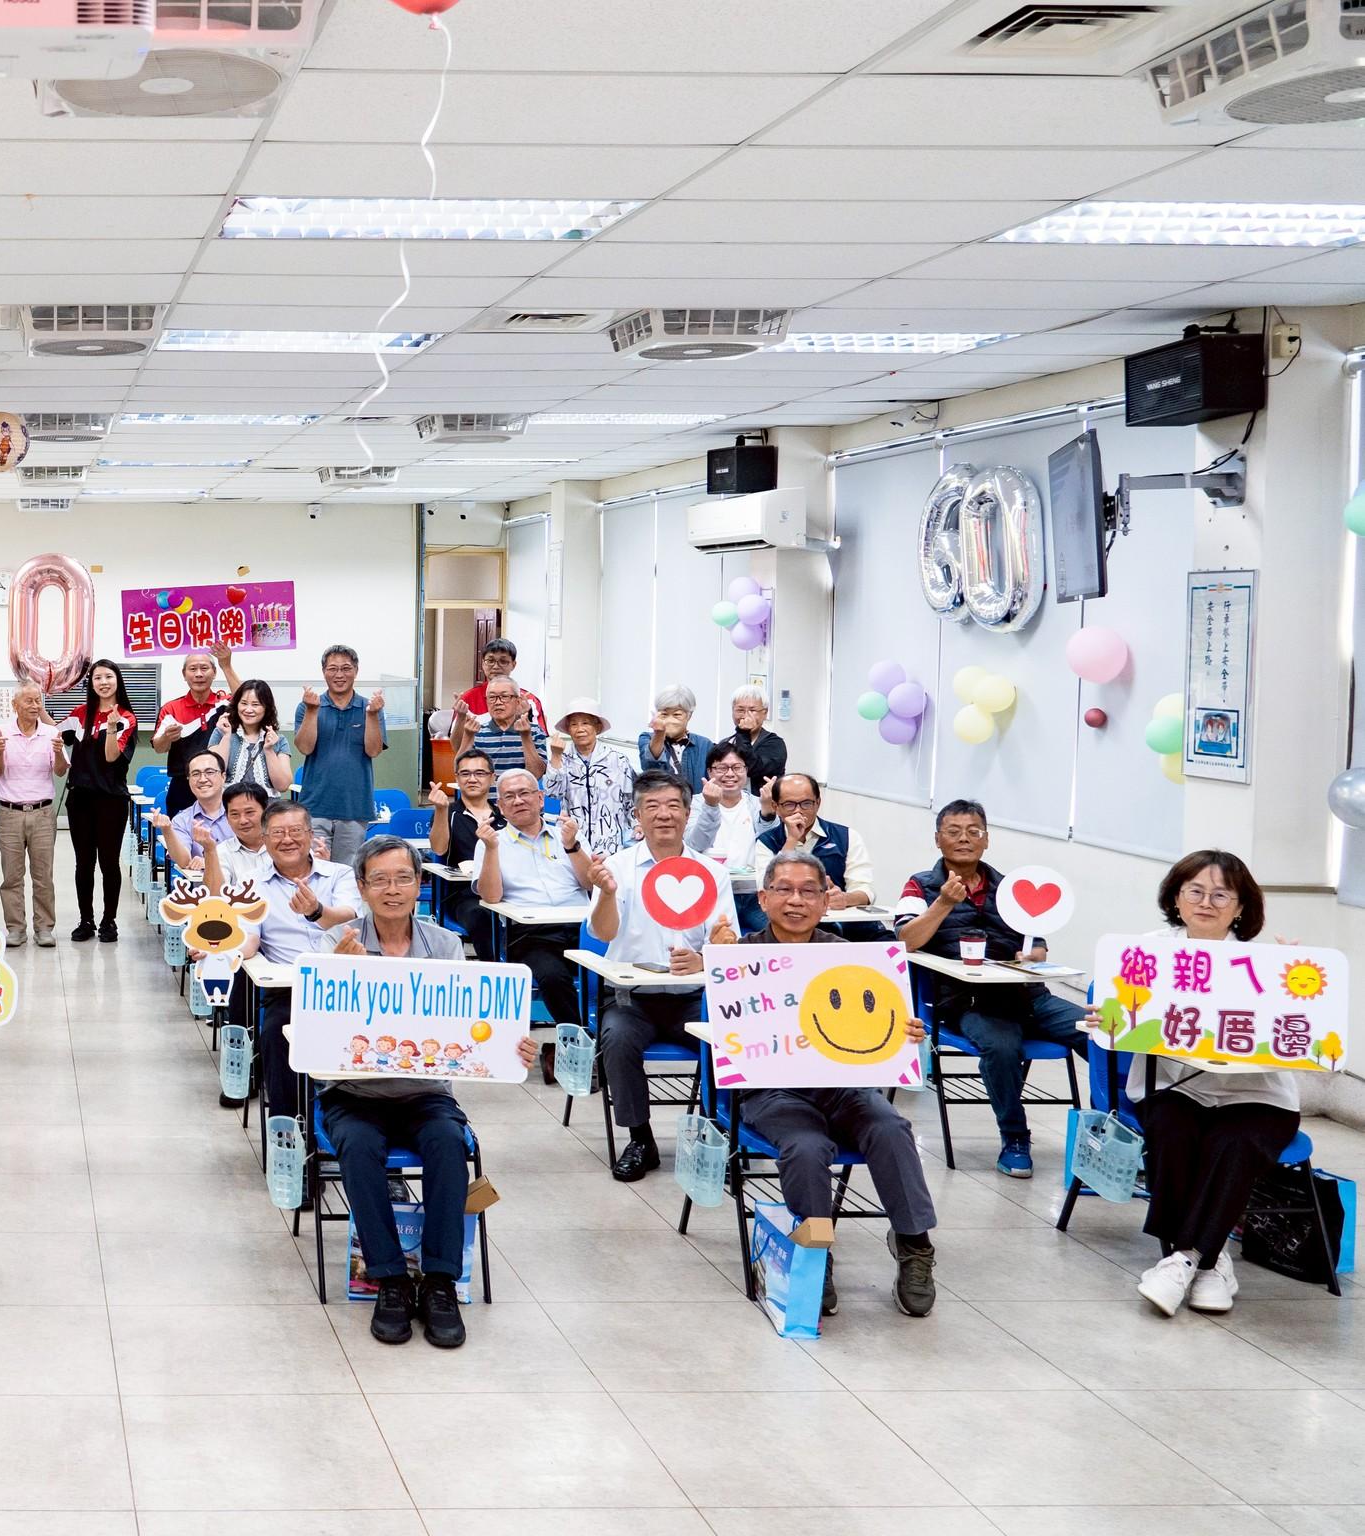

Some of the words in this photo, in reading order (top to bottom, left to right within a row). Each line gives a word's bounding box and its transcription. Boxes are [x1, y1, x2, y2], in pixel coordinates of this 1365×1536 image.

[1146, 381, 1162, 391] YANG
[128, 606, 247, 653] 生日快樂
[300, 966, 362, 1013] Thank
[365, 981, 404, 1026] you
[410, 971, 472, 1018] Yunlin
[478, 975, 526, 1021] DMV
[784, 993, 799, 1007] a
[724, 1031, 811, 1059] Smile
[1163, 1002, 1313, 1058] 好厝邊
